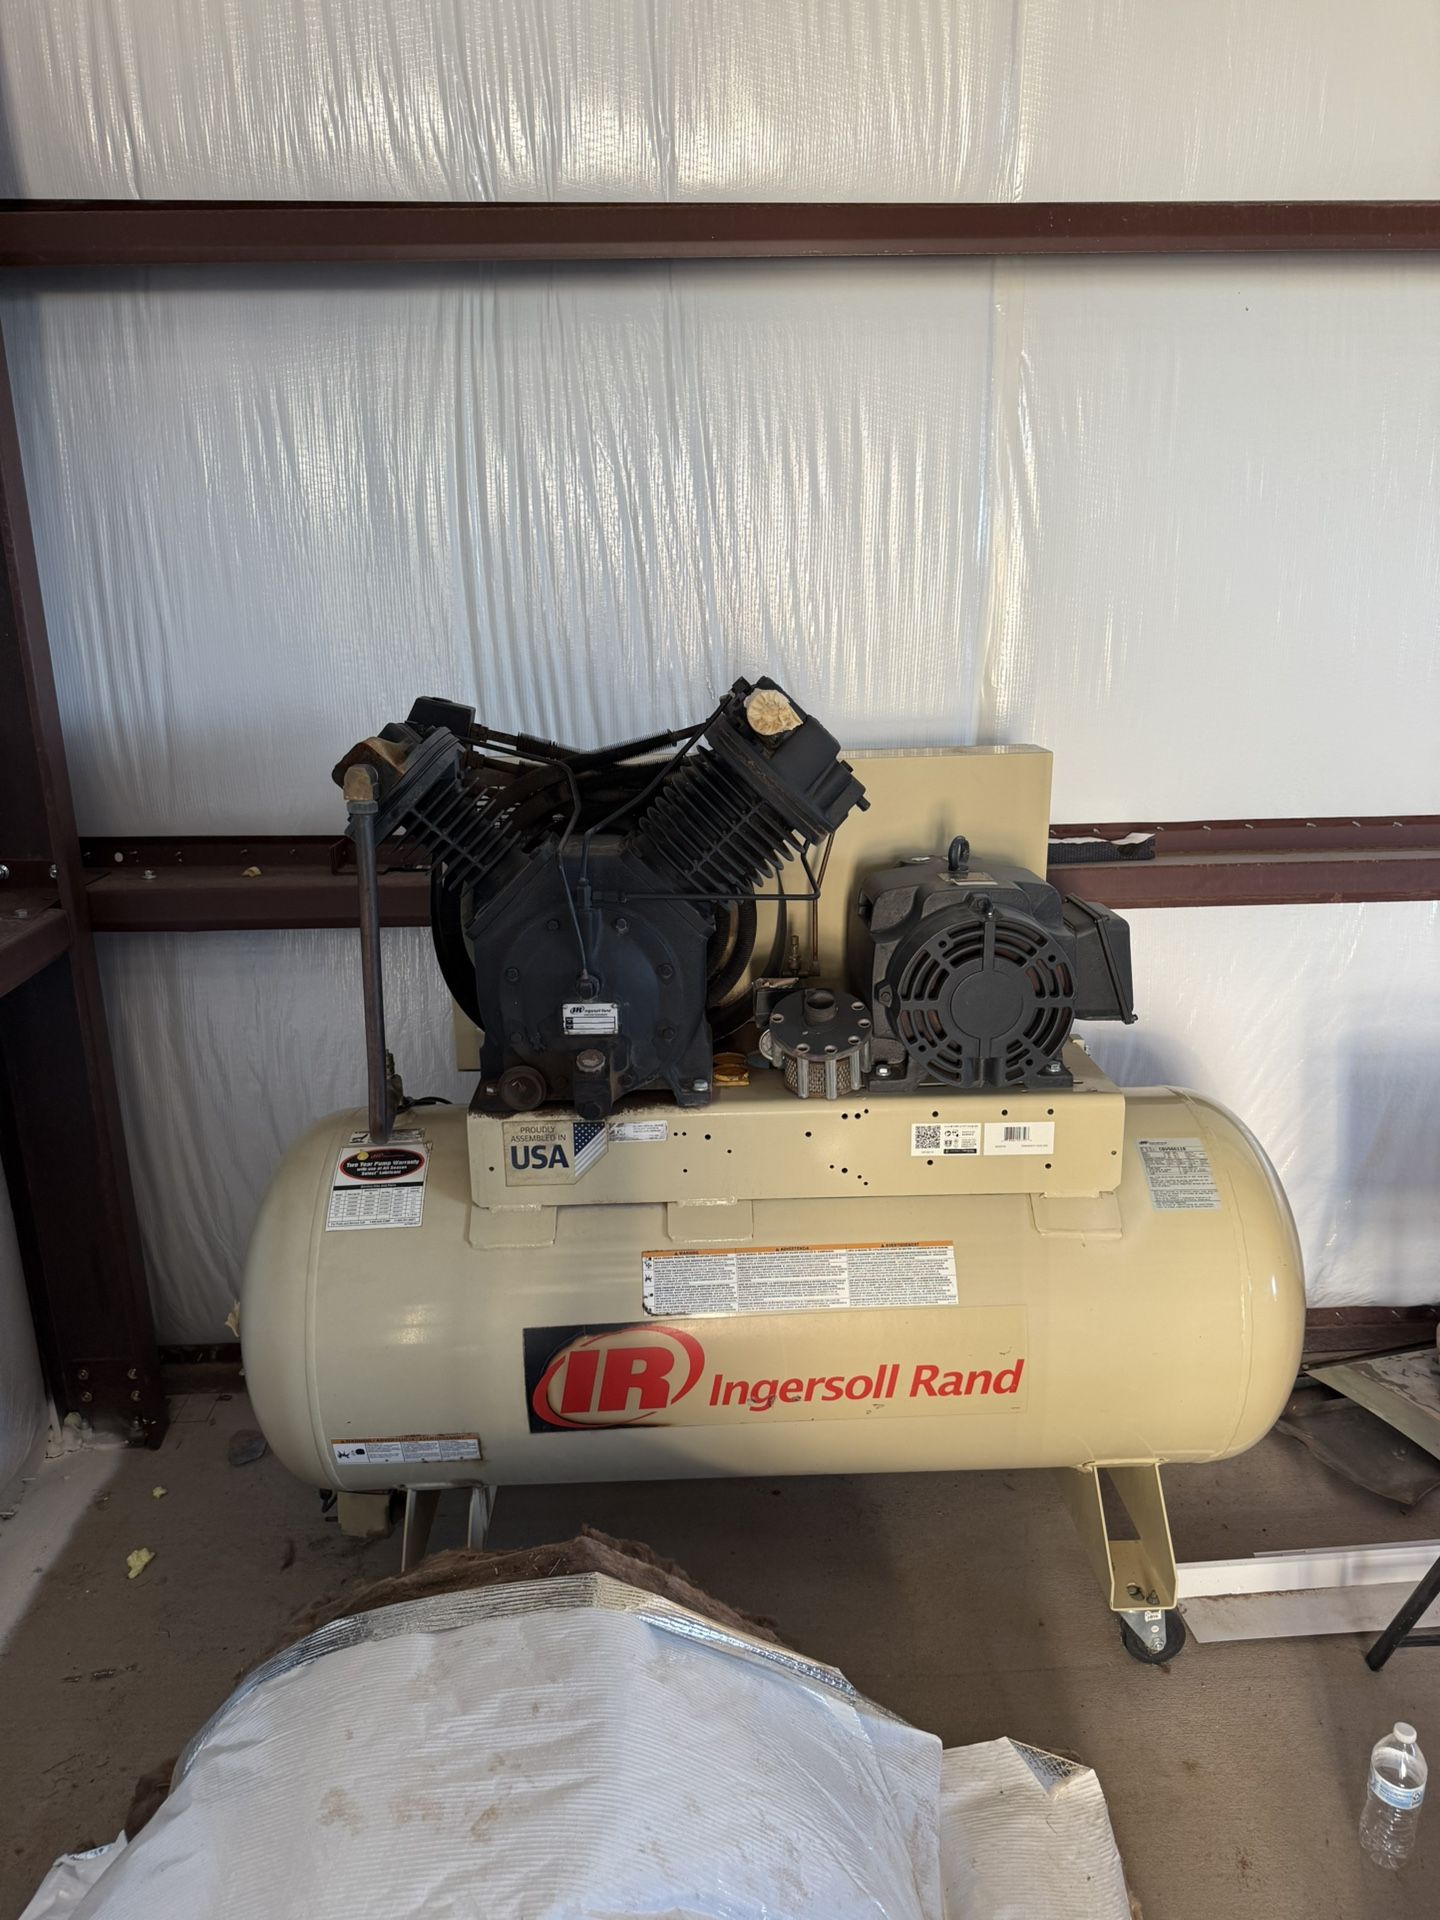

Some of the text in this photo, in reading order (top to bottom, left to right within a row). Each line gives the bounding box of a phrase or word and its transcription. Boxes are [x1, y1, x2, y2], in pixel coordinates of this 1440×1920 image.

[511, 1134, 556, 1142] ASSEMBLED
[520, 1126, 556, 1134] PROUDLY
[511, 1144, 569, 1170] USA
[561, 1347, 1024, 1413] IR Ingersoll Rand
